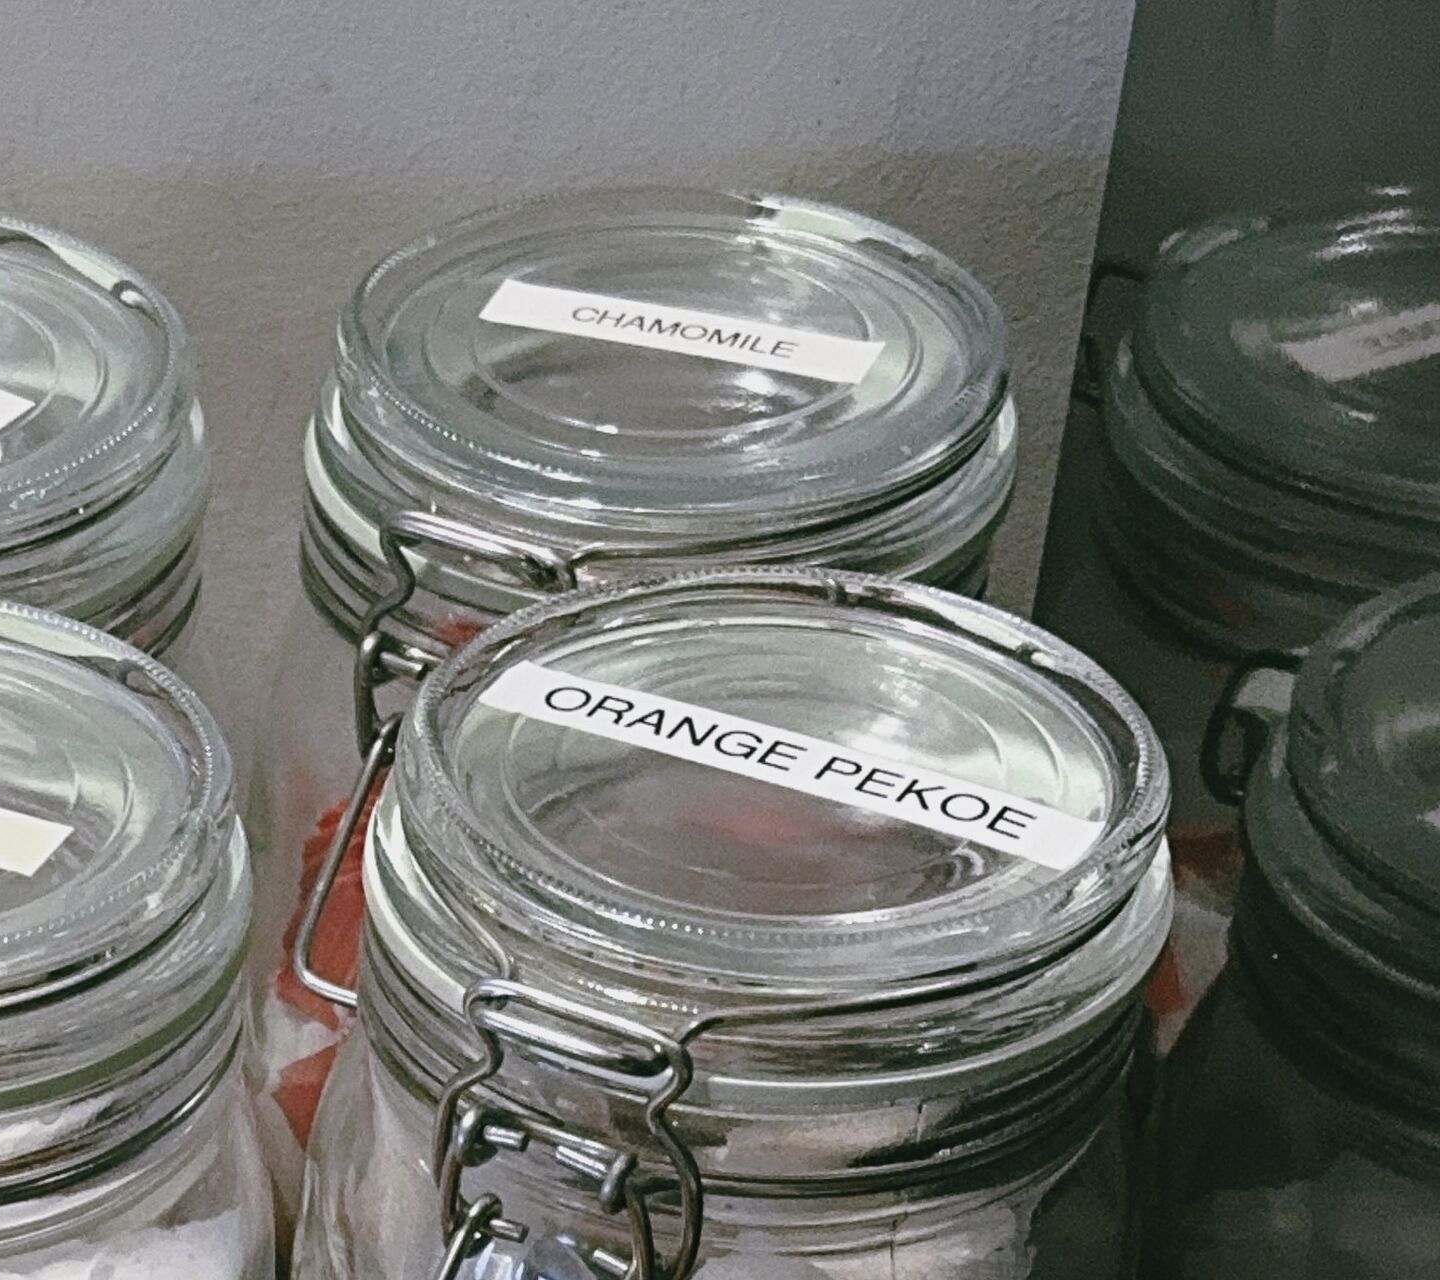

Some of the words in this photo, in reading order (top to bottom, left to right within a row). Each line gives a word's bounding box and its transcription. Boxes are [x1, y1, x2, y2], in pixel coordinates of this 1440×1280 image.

[571, 306, 800, 360] CHAMOMILE
[544, 685, 810, 773] ORANGE
[814, 756, 1037, 841] PEKOE
